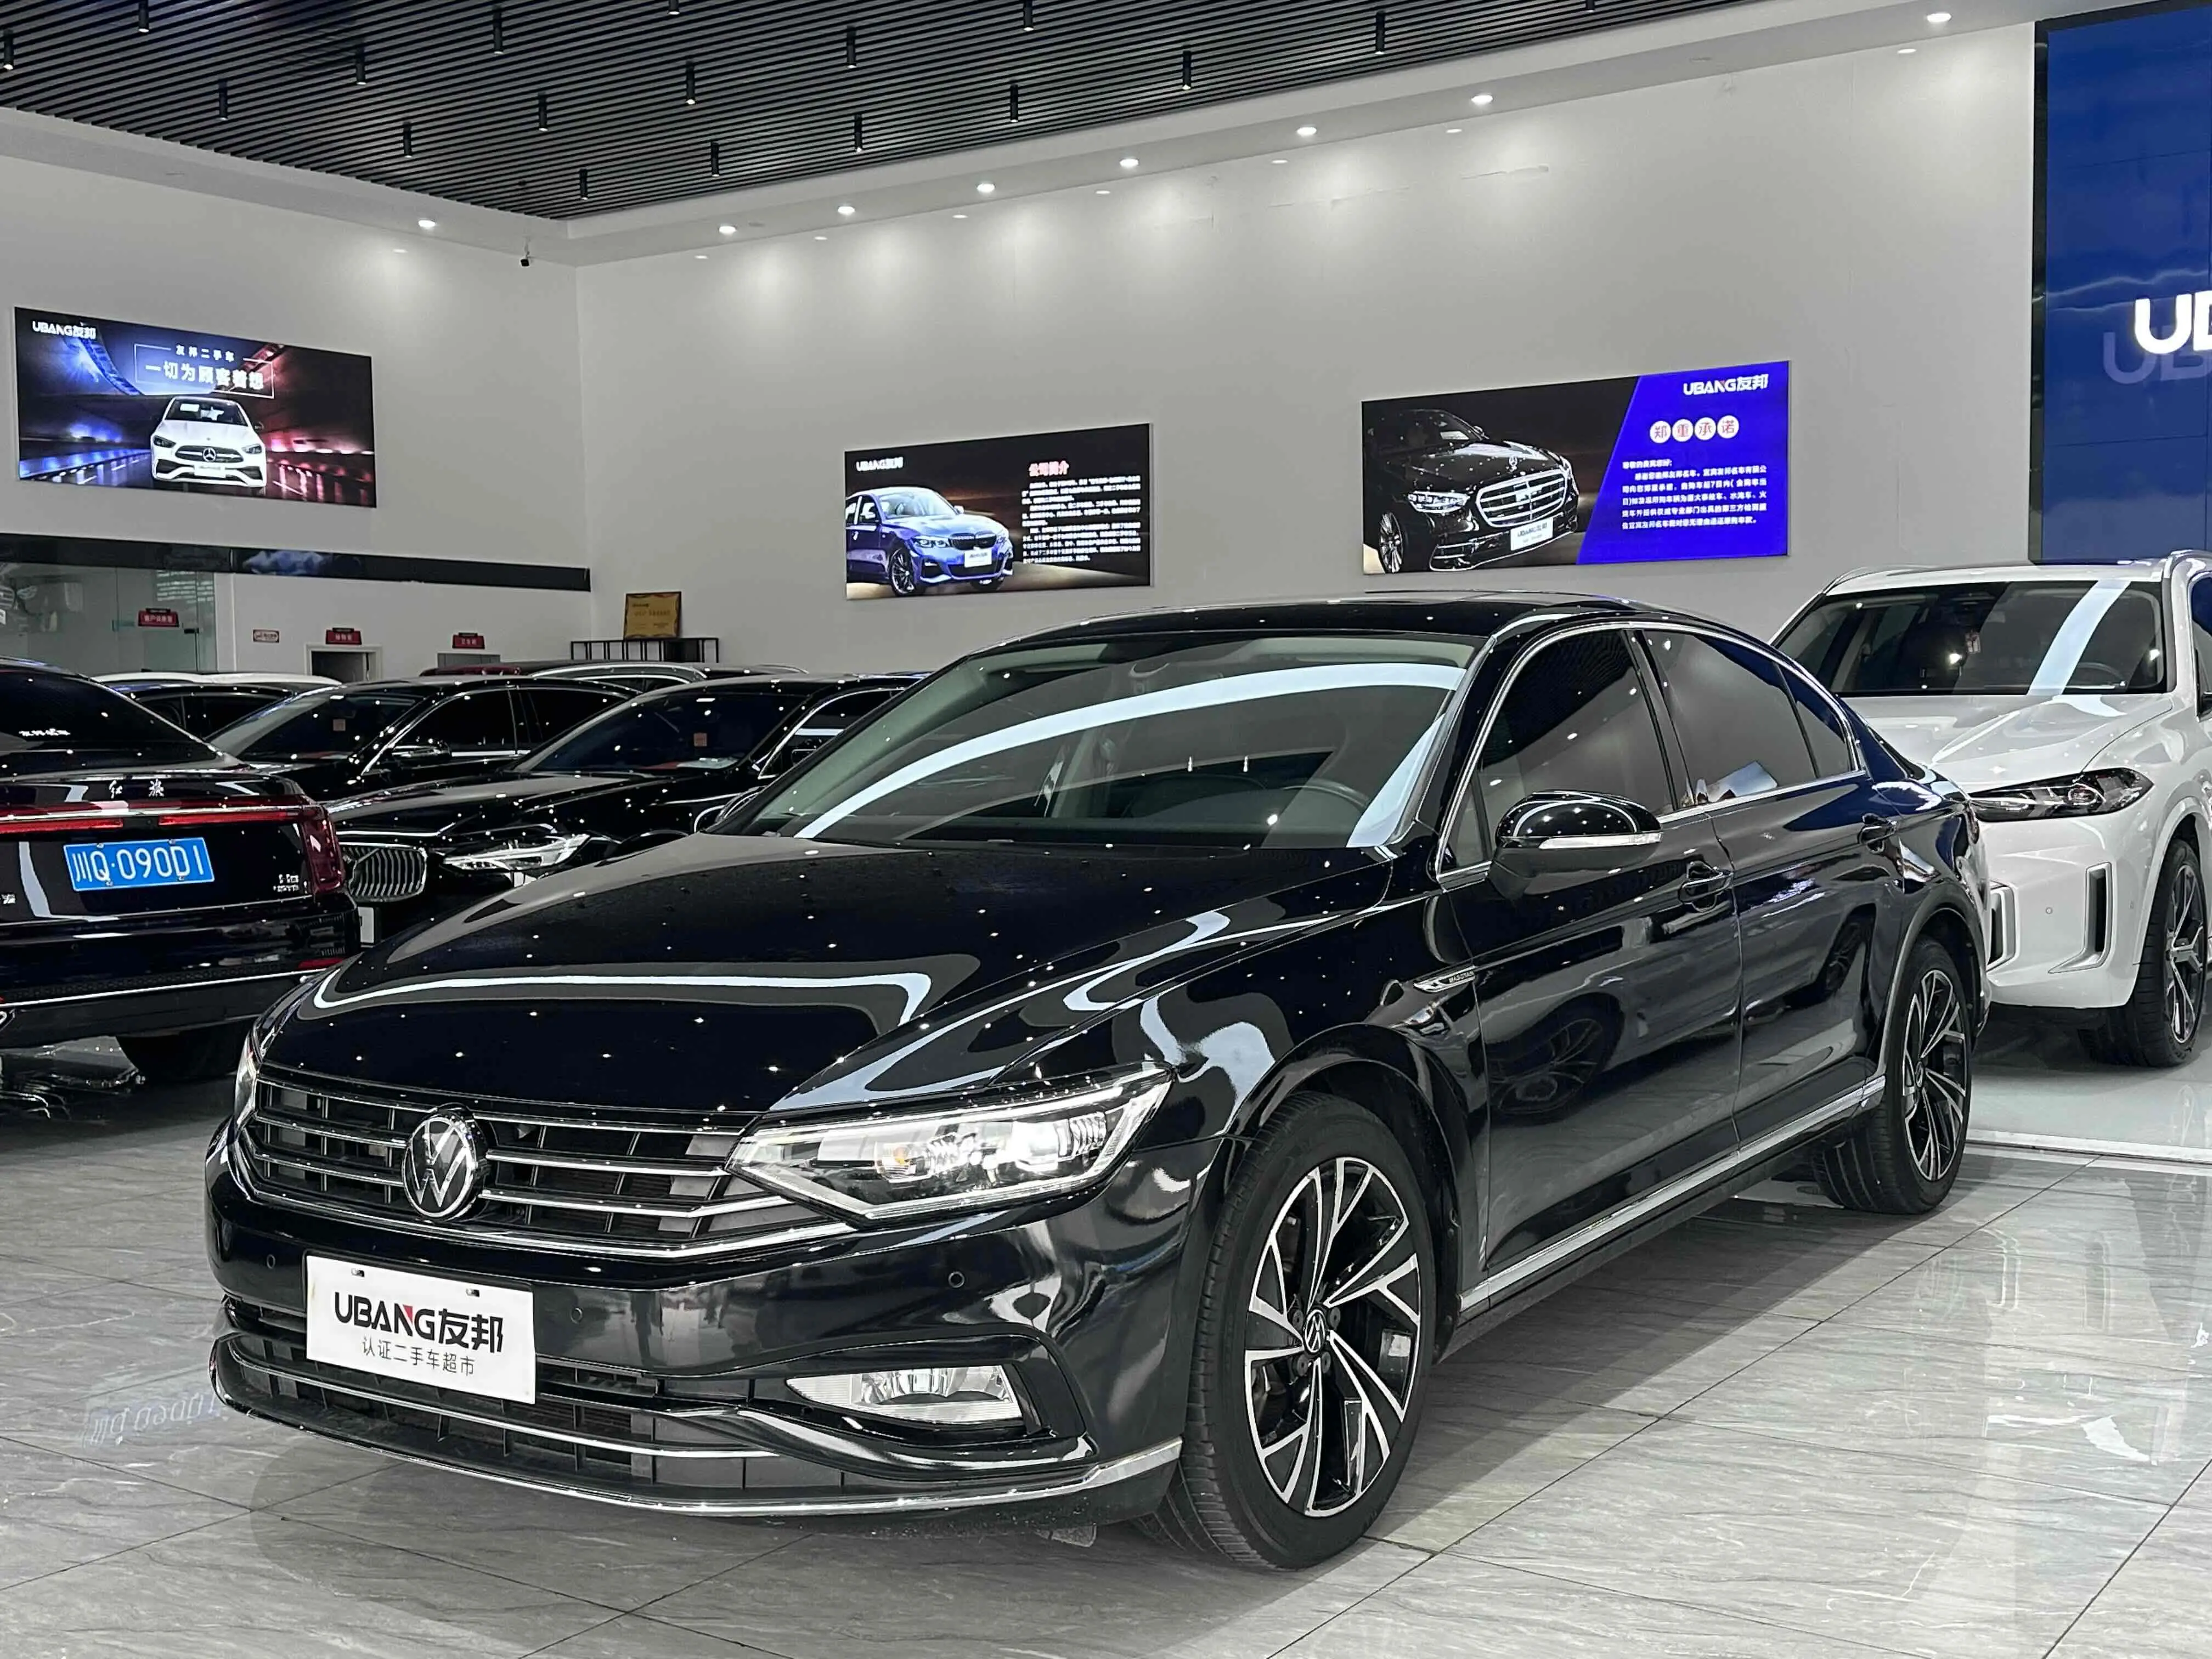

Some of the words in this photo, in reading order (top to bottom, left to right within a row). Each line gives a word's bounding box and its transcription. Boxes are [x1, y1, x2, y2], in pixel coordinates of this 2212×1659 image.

[1683, 374, 1769, 396] UBANG友邦
[1654, 419, 1735, 439] 郑重承诺
[335, 1291, 504, 1353] UBANG友邦
[362, 1336, 475, 1376] 认证二手车超市
